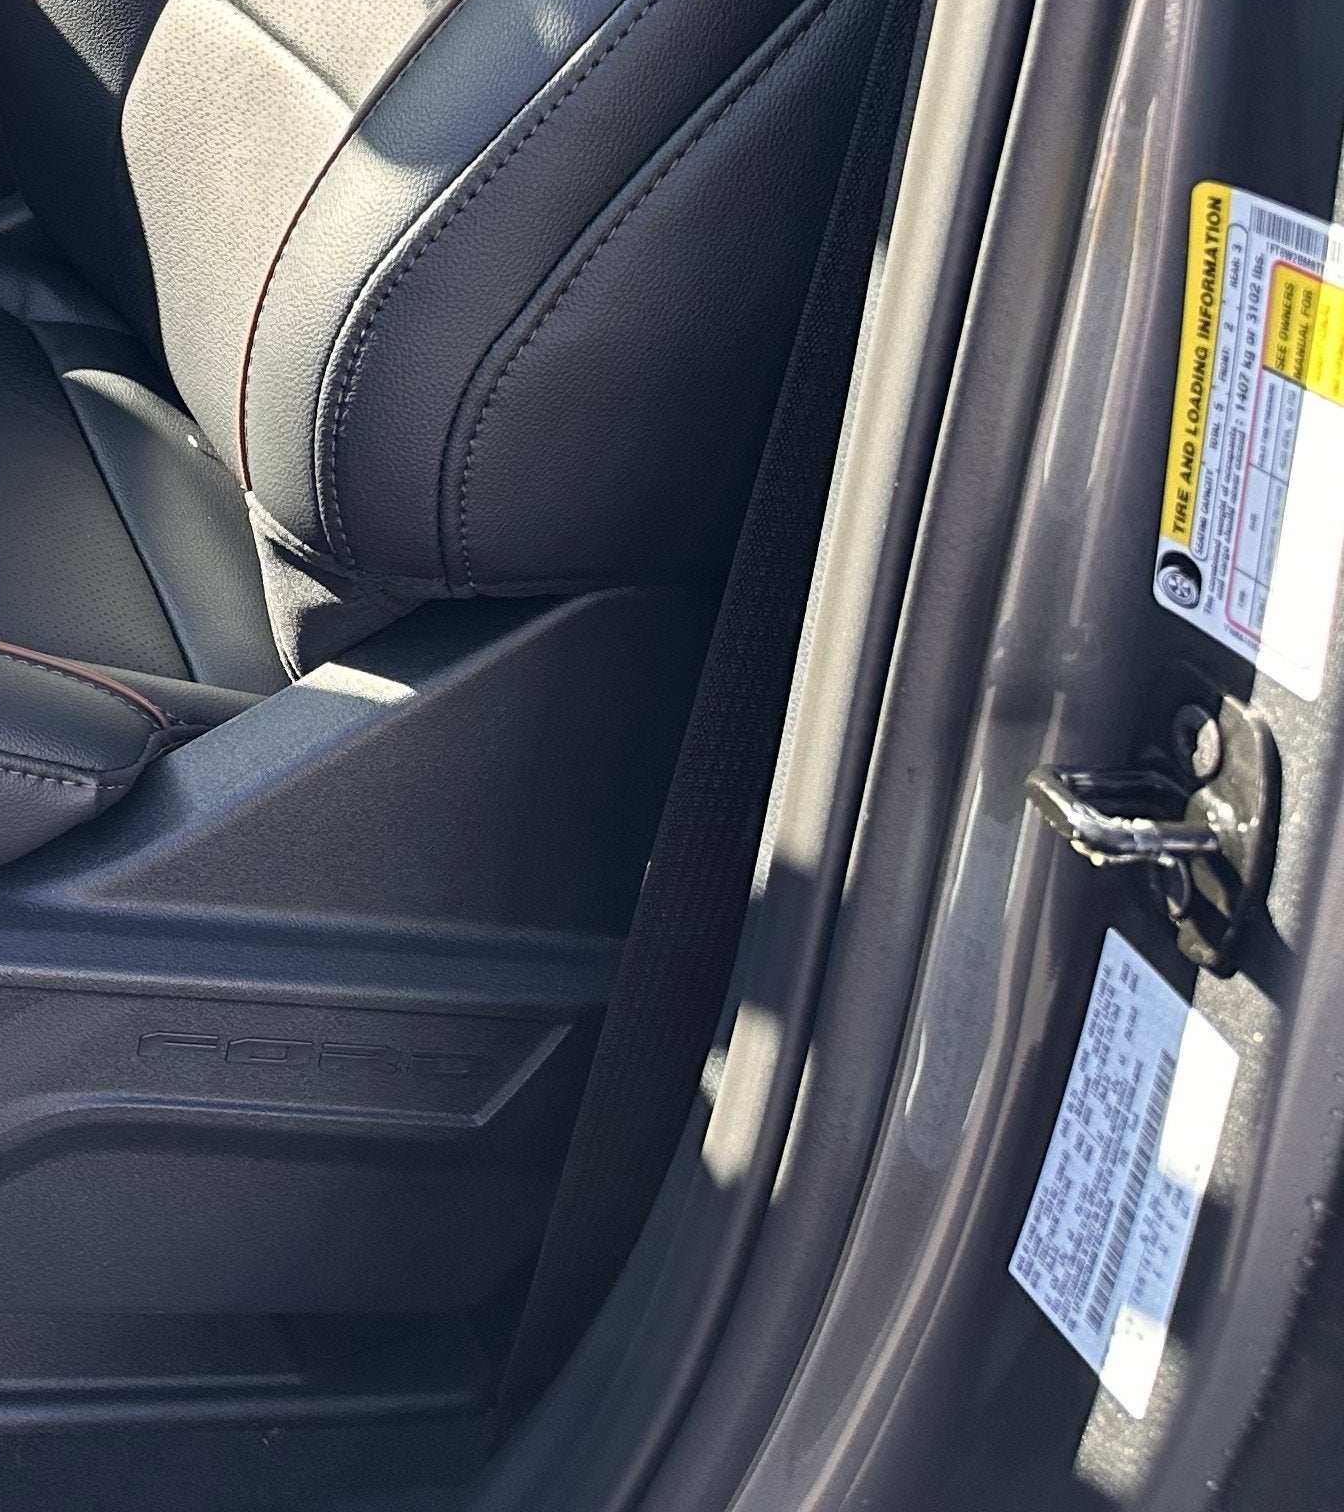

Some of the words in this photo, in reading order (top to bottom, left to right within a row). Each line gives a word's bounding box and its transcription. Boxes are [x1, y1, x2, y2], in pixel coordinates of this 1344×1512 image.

[1194, 194, 1223, 341] INFORMATION
[1249, 249, 1265, 281] lbs.
[1245, 280, 1261, 325] 3102
[1278, 280, 1294, 342] OWNERS
[1300, 287, 1312, 317] FOR
[1238, 346, 1255, 371] kg
[1244, 327, 1255, 346] or
[1274, 342, 1286, 372] SEE
[1293, 319, 1308, 381] MANUAL
[1185, 342, 1207, 438] LOADING
[1200, 465, 1213, 516] CAPACITY
[1224, 320, 1233, 332] 2
[1231, 242, 1242, 253] 3
[1234, 370, 1249, 413] 1407
[1179, 437, 1195, 485] AND
[1172, 485, 1188, 539] TIRE
[137, 1031, 480, 1076] FORD
